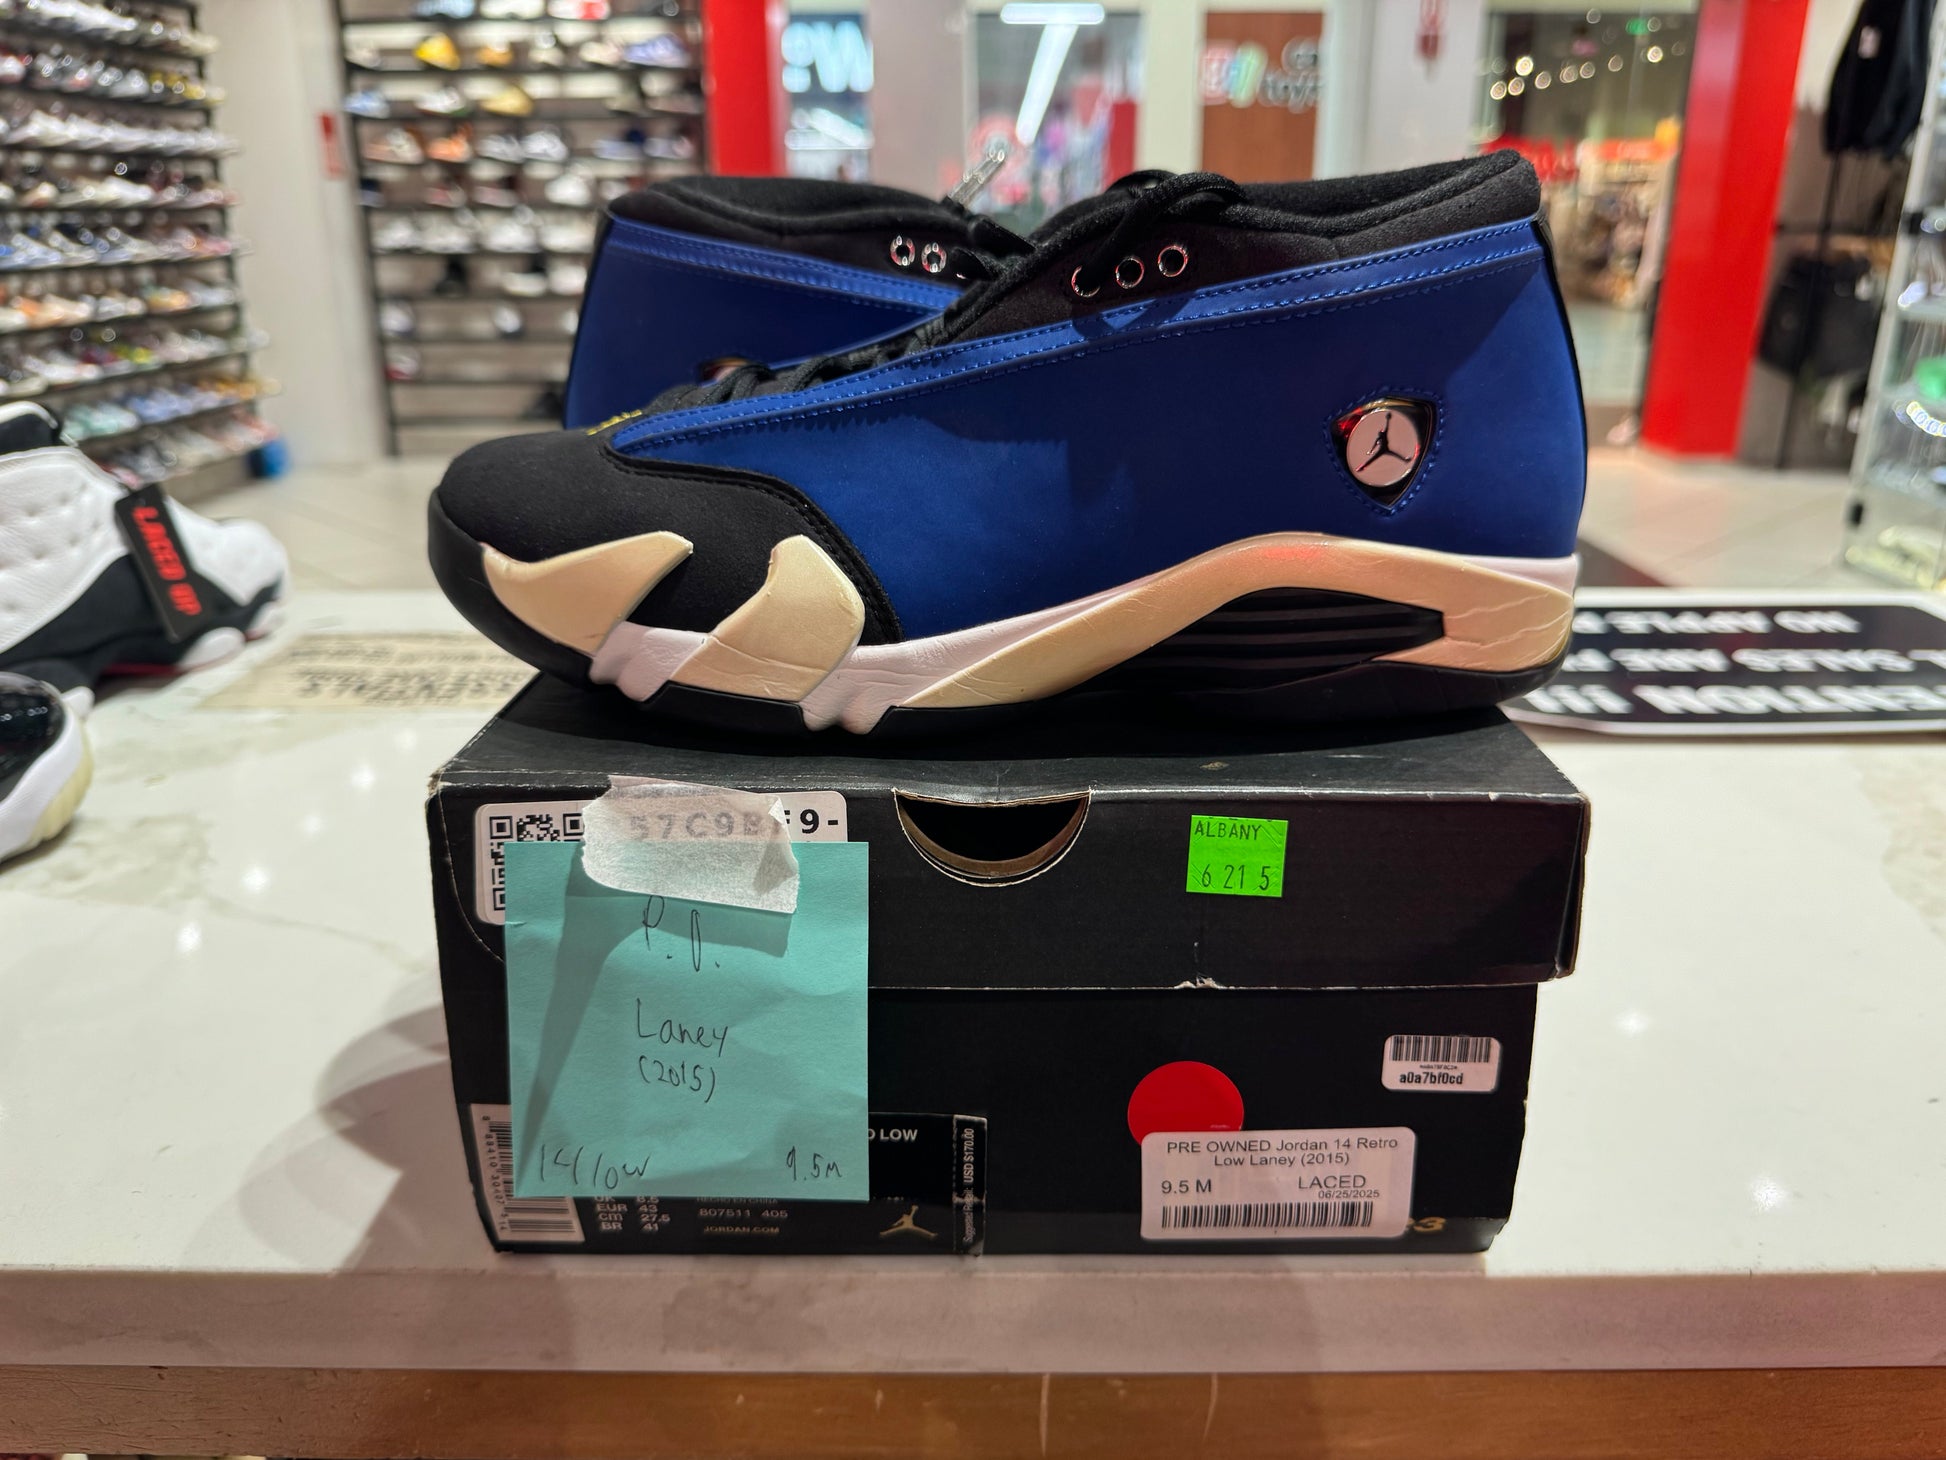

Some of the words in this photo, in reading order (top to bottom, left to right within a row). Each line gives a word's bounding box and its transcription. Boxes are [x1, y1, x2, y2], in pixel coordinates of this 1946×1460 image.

[1194, 820, 1262, 840] ALBANY
[1201, 864, 1212, 888] 6
[1223, 864, 1246, 889] 21
[1258, 866, 1271, 891] 5
[636, 998, 729, 1058] Laney
[639, 1055, 716, 1104] (2015)
[1399, 1072, 1464, 1085] a0a7bf0cd
[880, 1129, 918, 1141] LOW
[962, 1128, 975, 1161] $170.00
[1167, 1141, 1201, 1154] PRE
[1206, 1139, 1271, 1153] OWNED
[1276, 1138, 1328, 1152] Jordan
[1334, 1137, 1351, 1150] 14
[1357, 1136, 1398, 1150] Retro
[1214, 1155, 1244, 1166] Low
[1250, 1154, 1296, 1168] Laney
[1301, 1152, 1350, 1167] (2015)
[963, 1163, 974, 1183] USD
[1161, 1180, 1190, 1194] 9.5
[1196, 1179, 1212, 1193] M
[1298, 1175, 1367, 1189] LACED
[1318, 1190, 1380, 1199] 06/25/2025
[597, 1203, 628, 1212] EUR
[638, 1205, 658, 1213] 43
[699, 1208, 751, 1218] 807511
[761, 1210, 788, 1218] 405
[640, 1213, 671, 1223] 27.5
[601, 1222, 623, 1231] BR
[643, 1222, 659, 1231] 41
